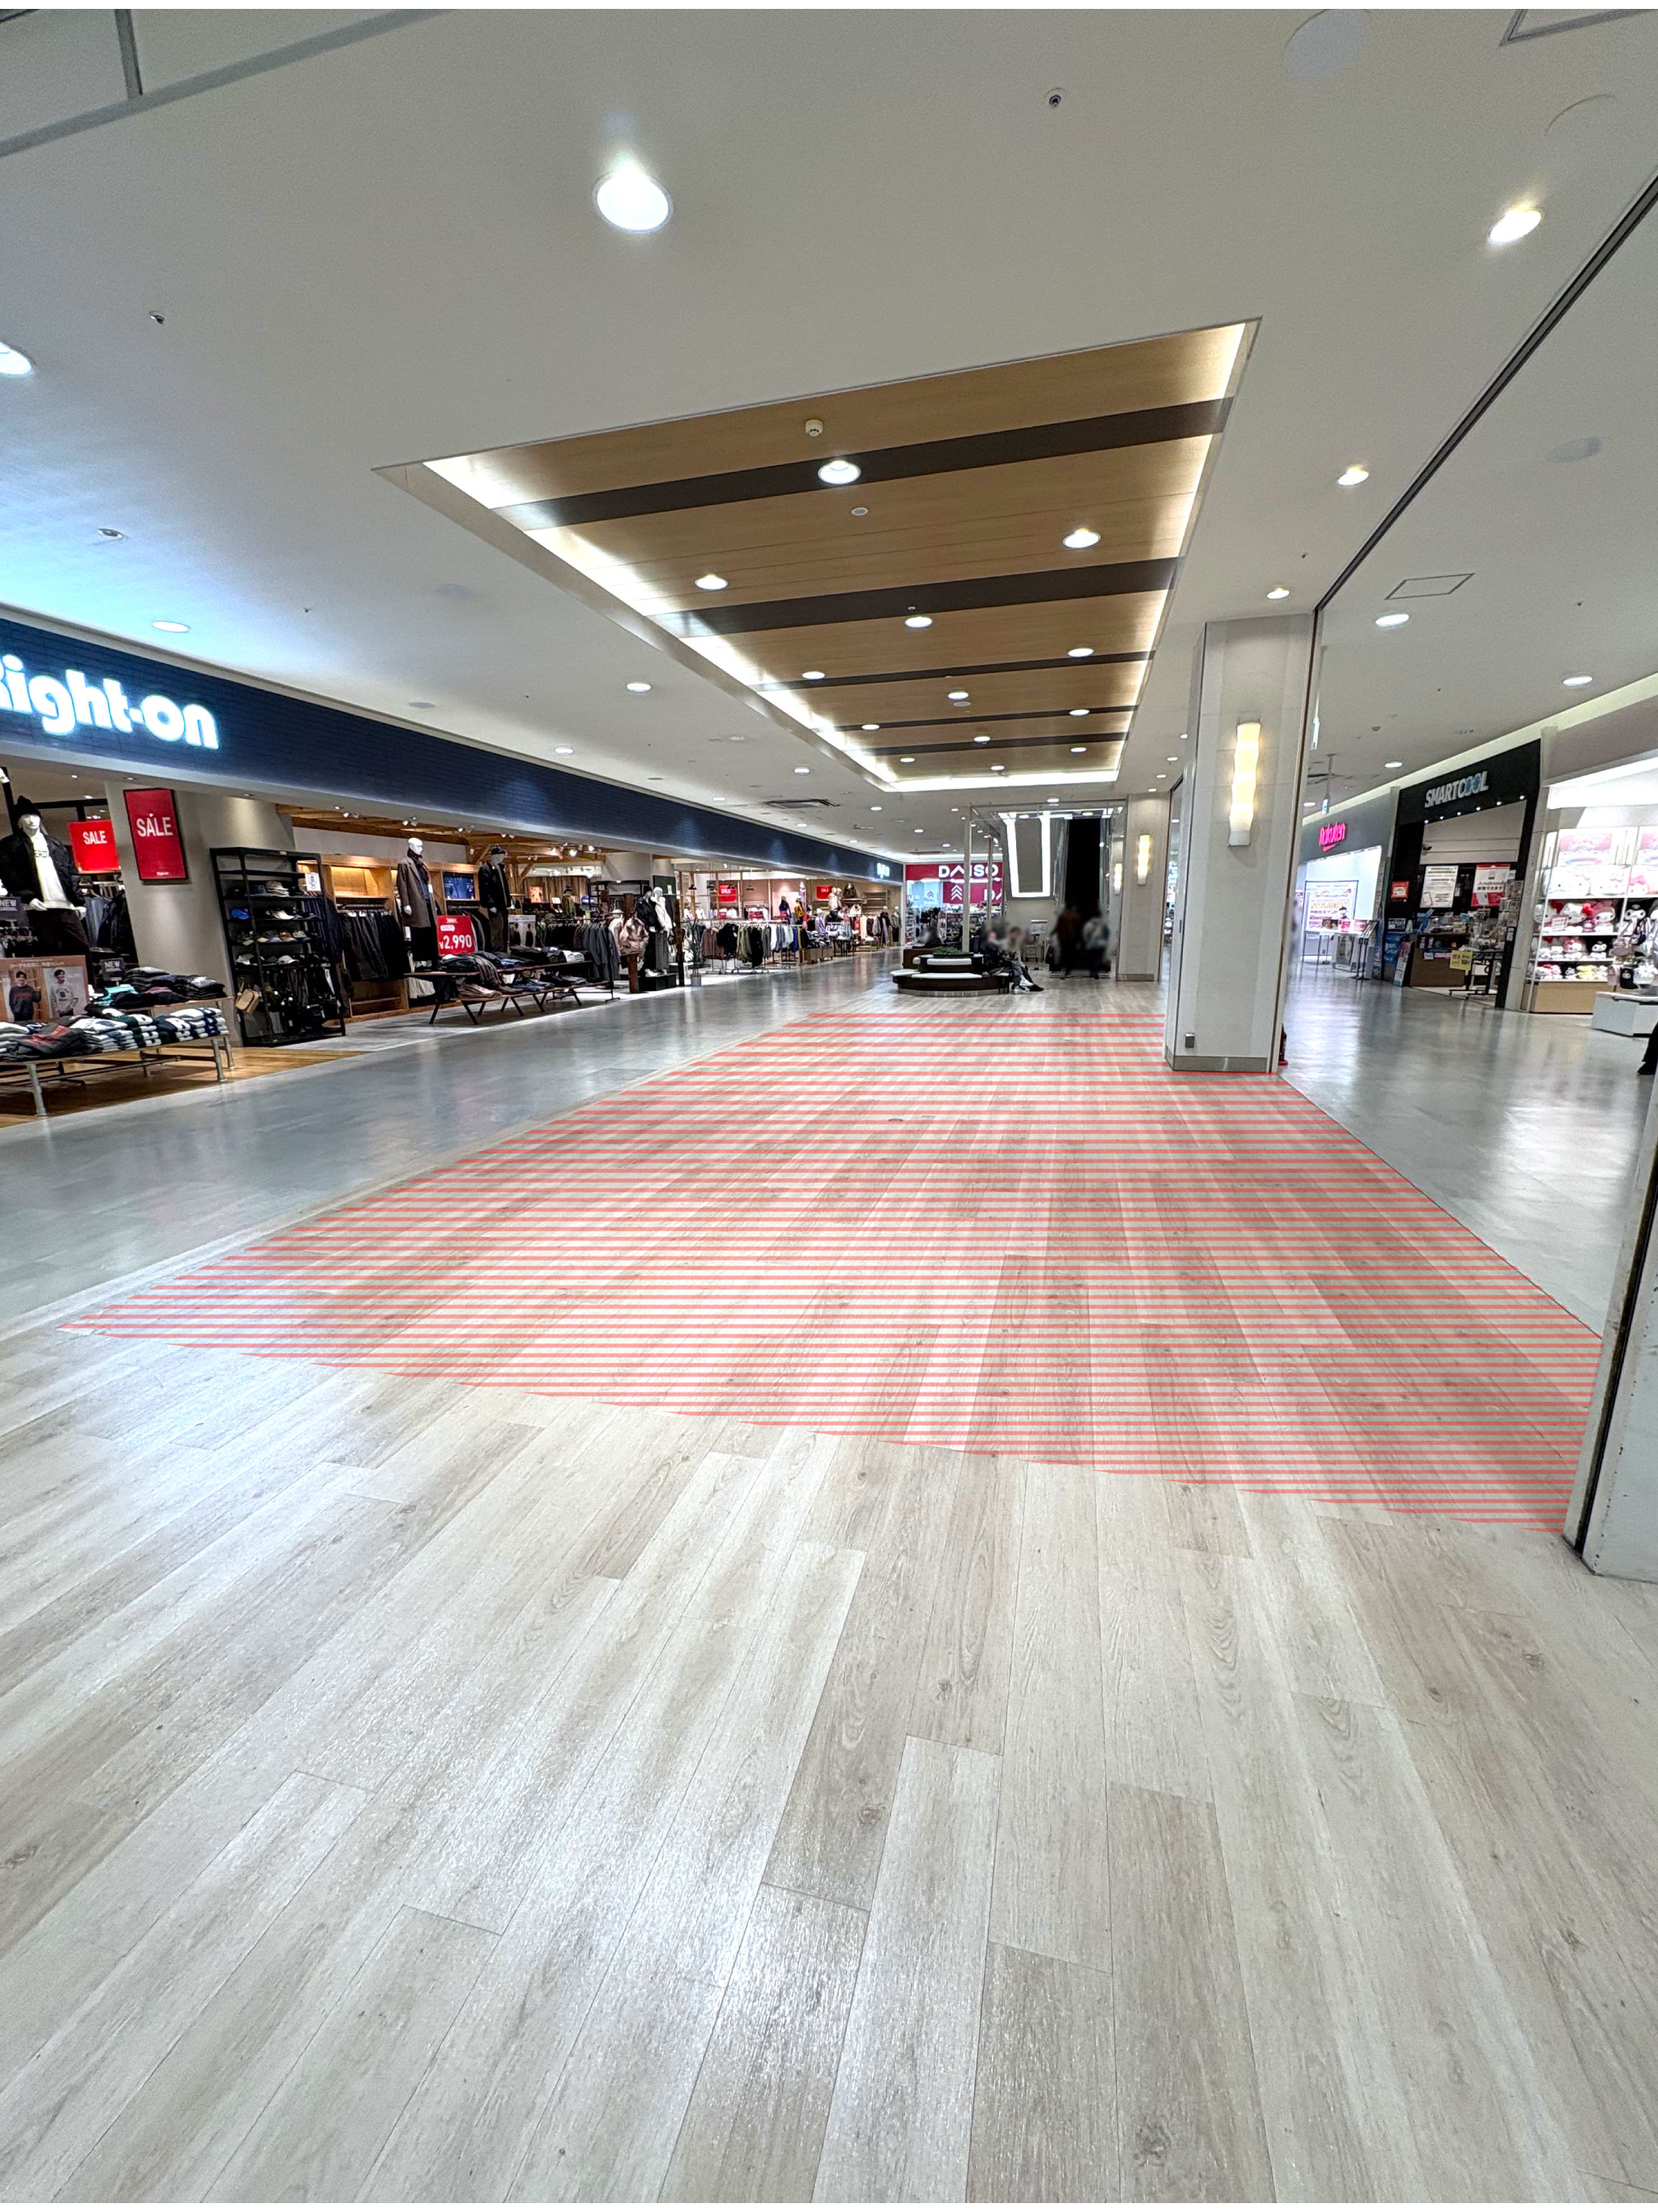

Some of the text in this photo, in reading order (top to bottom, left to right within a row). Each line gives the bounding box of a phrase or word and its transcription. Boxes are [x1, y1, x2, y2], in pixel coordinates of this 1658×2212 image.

[1425, 771, 1489, 808] SMARTCOOL
[136, 817, 174, 837] SALE
[1319, 823, 1346, 846] Rakuten
[83, 830, 108, 845] SALE
[104, 960, 121, 968] NEW
